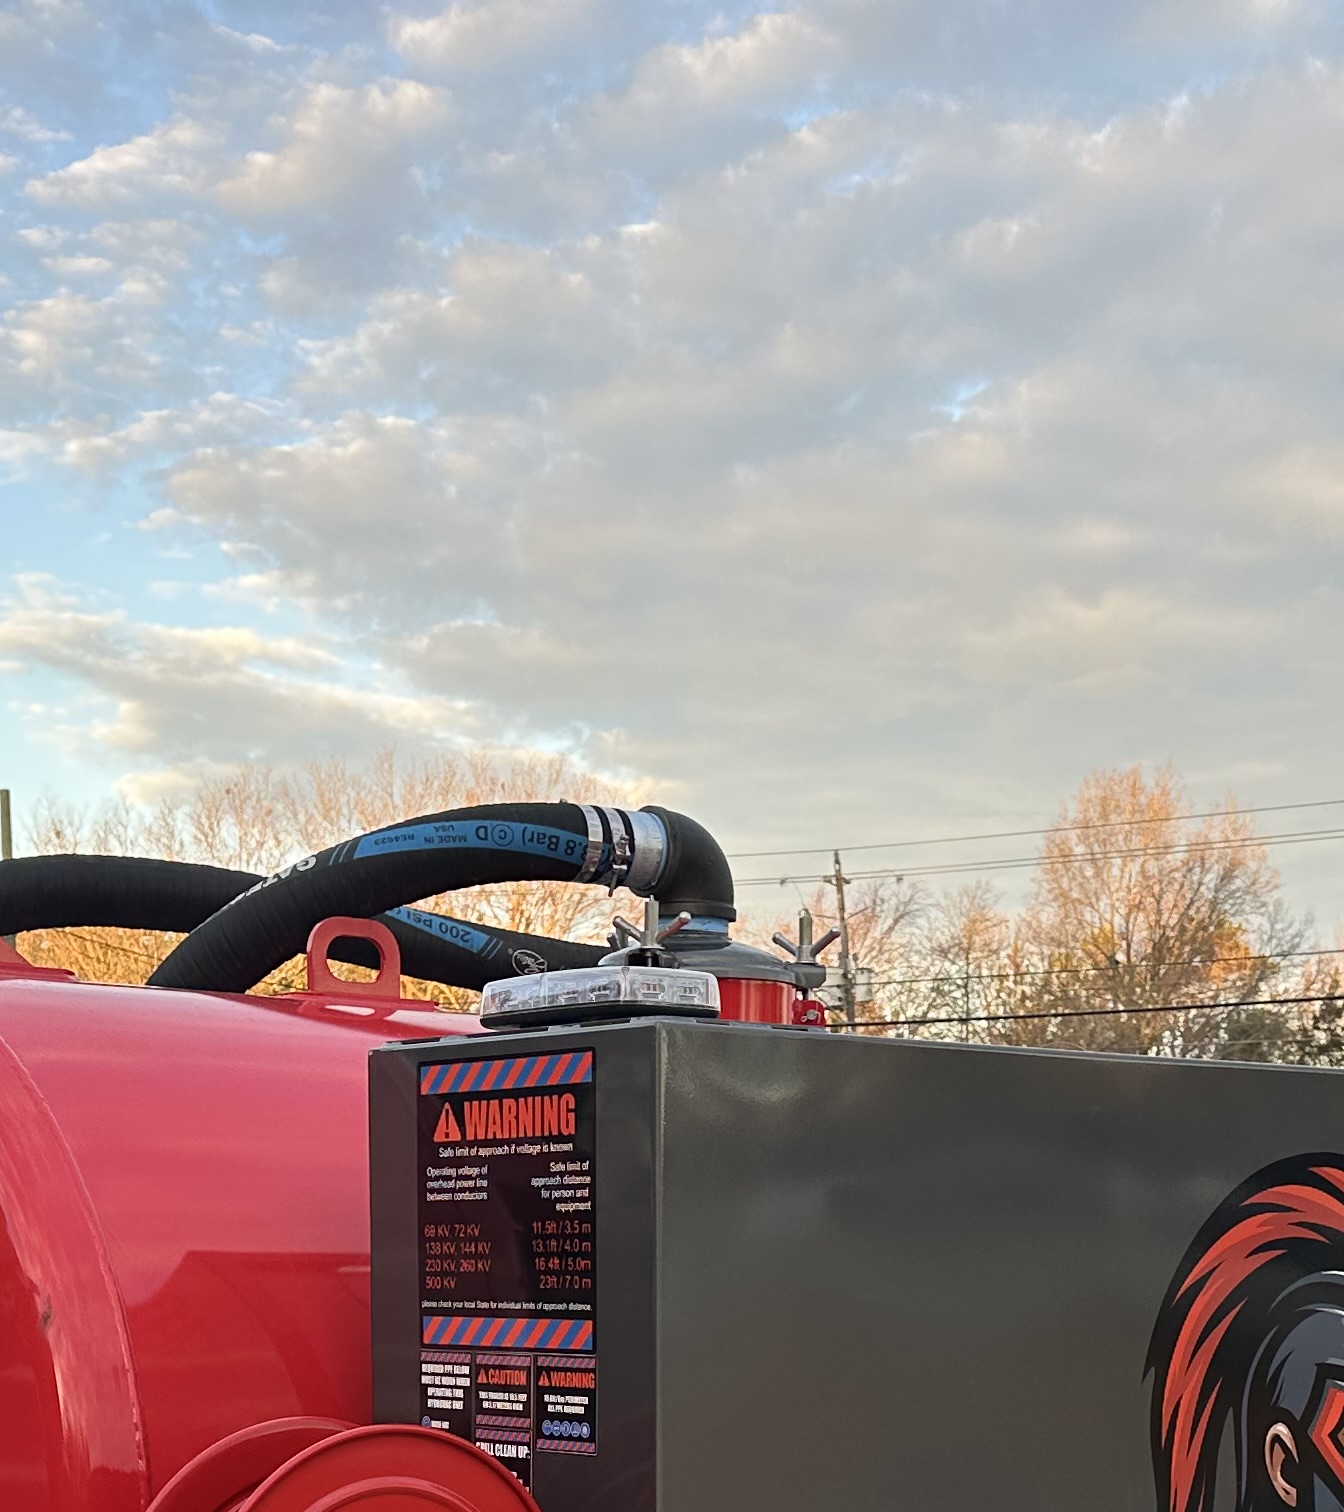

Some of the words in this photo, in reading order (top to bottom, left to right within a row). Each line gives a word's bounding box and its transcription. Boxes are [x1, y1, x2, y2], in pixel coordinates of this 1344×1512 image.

[434, 823, 455, 833] USA
[423, 836, 436, 844] IN
[437, 833, 468, 844] MADE
[521, 827, 560, 851] Bar)
[230, 855, 317, 905] GATE
[406, 911, 434, 929] PSI
[438, 921, 473, 943] 200
[463, 1093, 576, 1141] WARNING
[439, 1146, 455, 1158] Safe
[456, 1146, 469, 1157] limit
[470, 1145, 478, 1156] of
[478, 1144, 509, 1158] approach
[516, 1143, 541, 1155] voltage
[550, 1142, 573, 1152] known
[426, 1166, 457, 1178] Operating
[458, 1165, 481, 1177] voltage
[481, 1164, 489, 1175] of
[549, 1161, 566, 1172] Safe
[567, 1161, 581, 1171] limit
[581, 1160, 590, 1171] of
[426, 1179, 456, 1189] overhead
[456, 1179, 475, 1190] power
[476, 1178, 488, 1188] line
[531, 1175, 561, 1187] approach
[562, 1174, 591, 1185] distance
[426, 1192, 453, 1202] between
[453, 1191, 488, 1201] conductors
[541, 1188, 551, 1199] for
[551, 1189, 575, 1200] person
[576, 1188, 589, 1197] and
[454, 1224, 465, 1237] 72
[467, 1223, 481, 1237] KV
[564, 1219, 580, 1234] 3.5
[581, 1223, 592, 1234] m
[459, 1242, 476, 1255] 144
[477, 1242, 492, 1255] KV
[564, 1239, 580, 1253] 4.0
[581, 1241, 592, 1253] m
[425, 1259, 442, 1272] 230
[477, 1259, 492, 1272] KV
[425, 1276, 442, 1289] 500
[443, 1276, 457, 1289] KV
[539, 1275, 558, 1289] 23ft
[581, 1278, 592, 1289] m
[488, 1368, 527, 1386] CAUTION
[550, 1371, 596, 1389] WARNING
[494, 1444, 517, 1458] CLEAN
